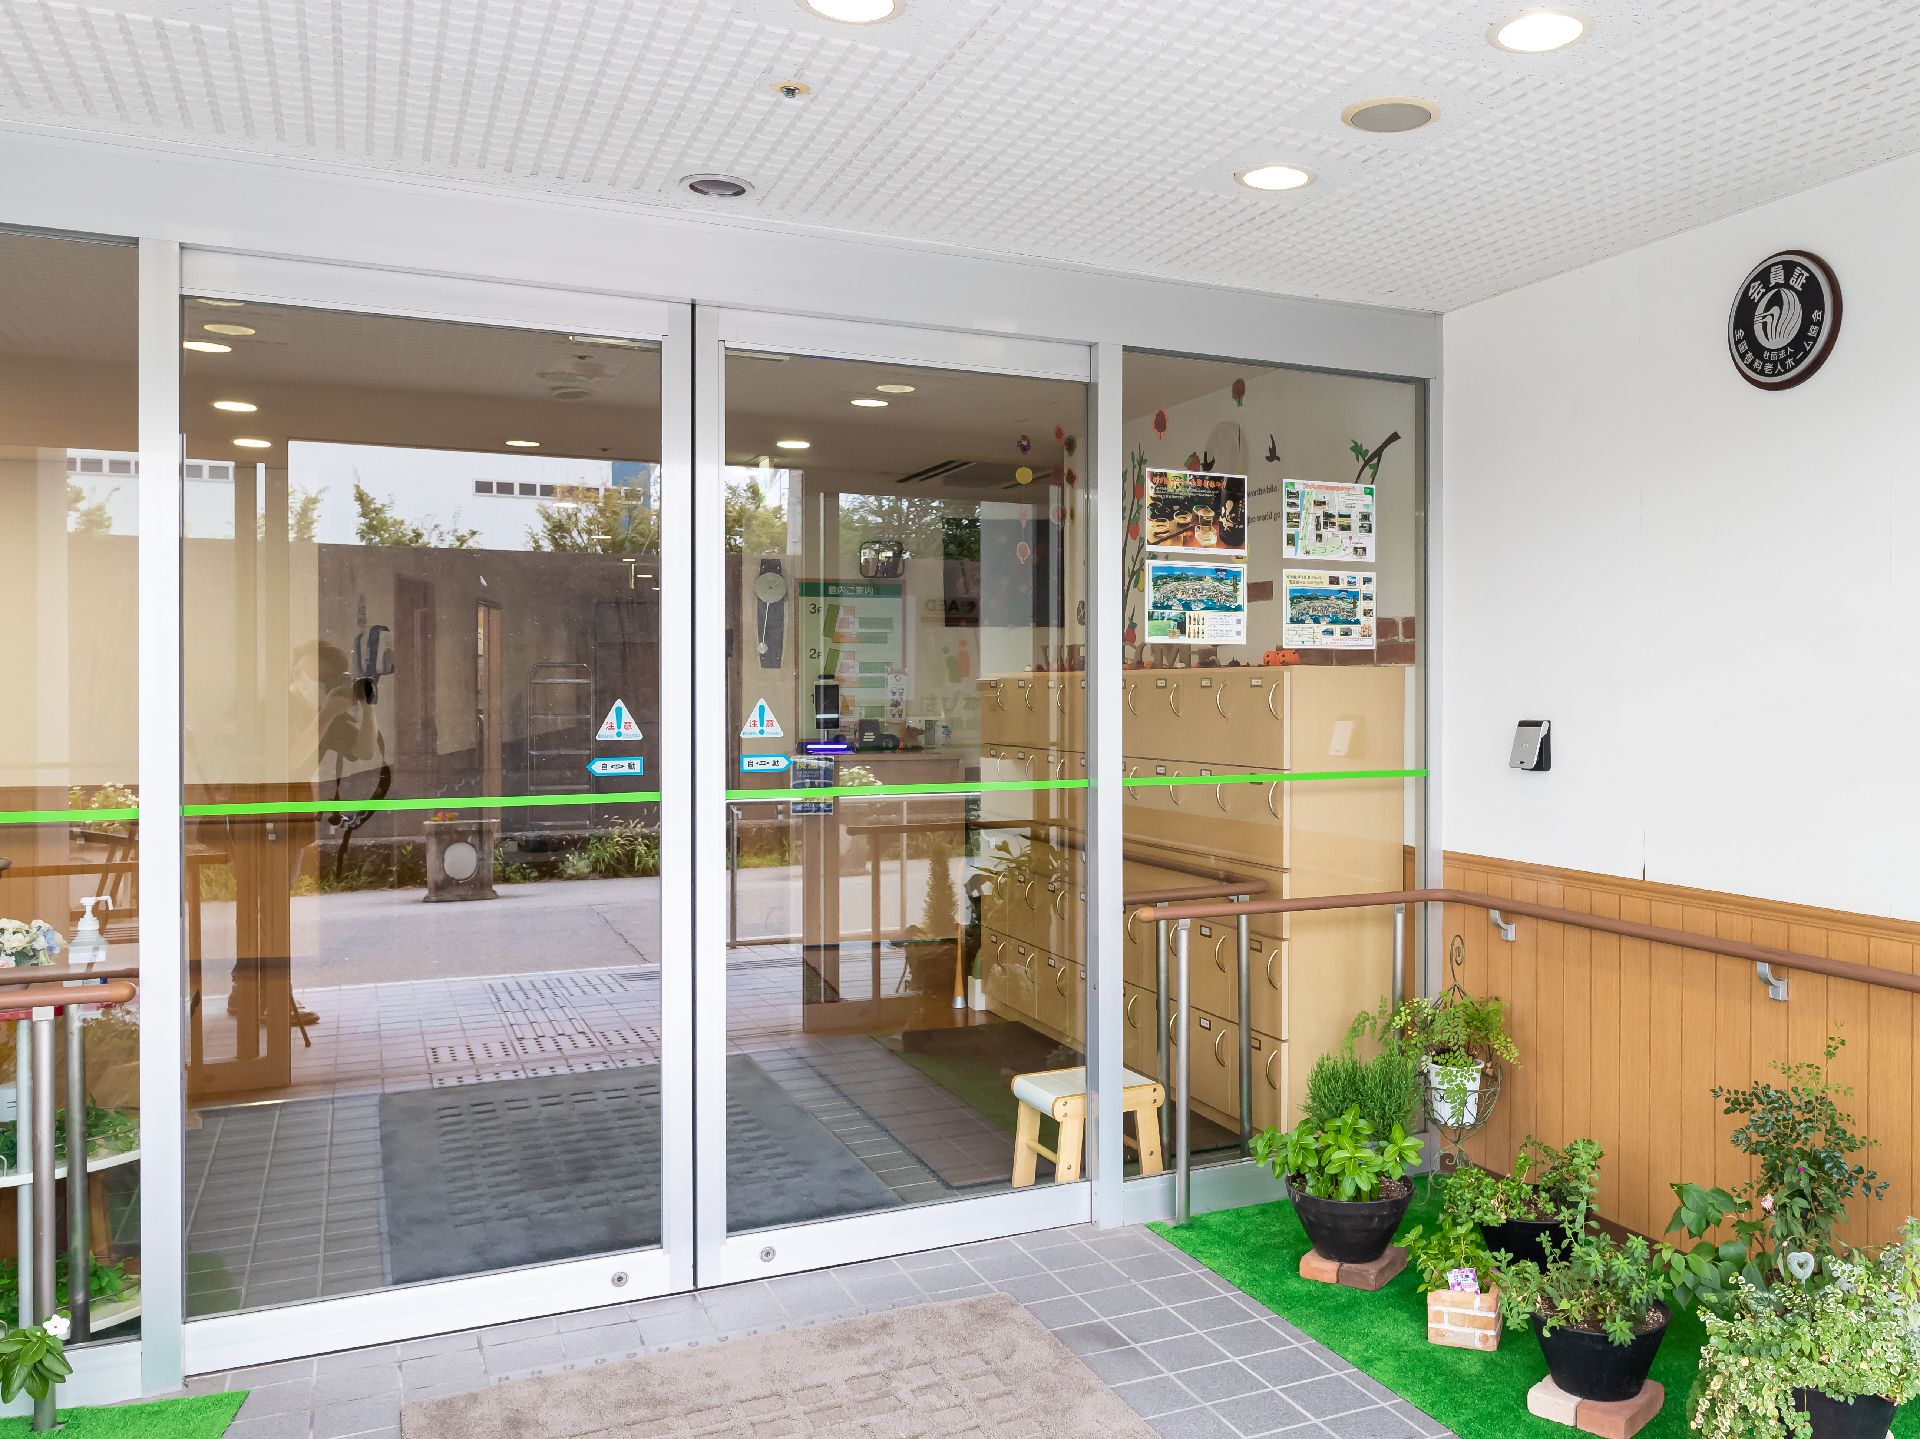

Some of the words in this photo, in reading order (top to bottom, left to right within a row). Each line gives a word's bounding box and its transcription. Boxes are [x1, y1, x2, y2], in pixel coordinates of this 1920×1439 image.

[1748, 264, 1809, 303] 会員証
[809, 603, 822, 615] 3F
[809, 648, 822, 660] 2F
